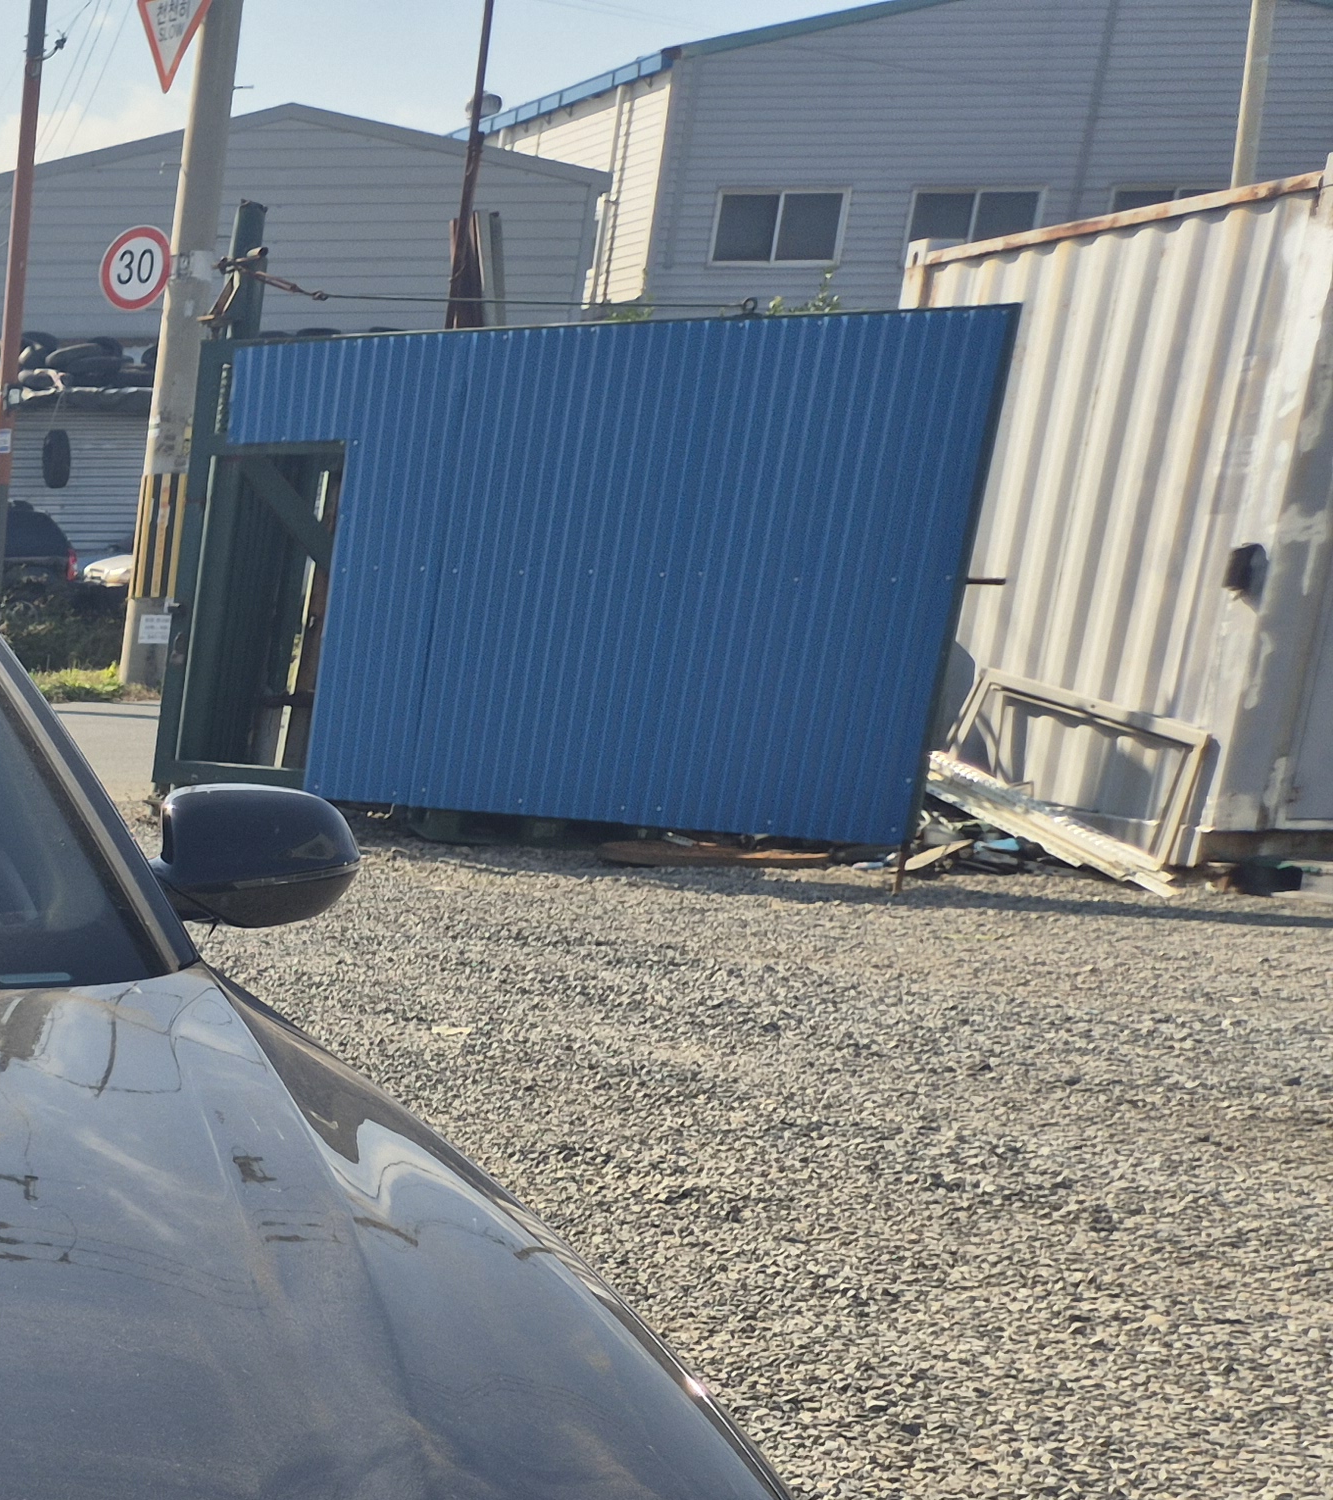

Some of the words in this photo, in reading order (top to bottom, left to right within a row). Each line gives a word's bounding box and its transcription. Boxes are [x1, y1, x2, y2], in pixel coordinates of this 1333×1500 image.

[157, 0, 190, 25] 천천히
[158, 23, 185, 42] SLOW
[117, 249, 154, 284] 30
